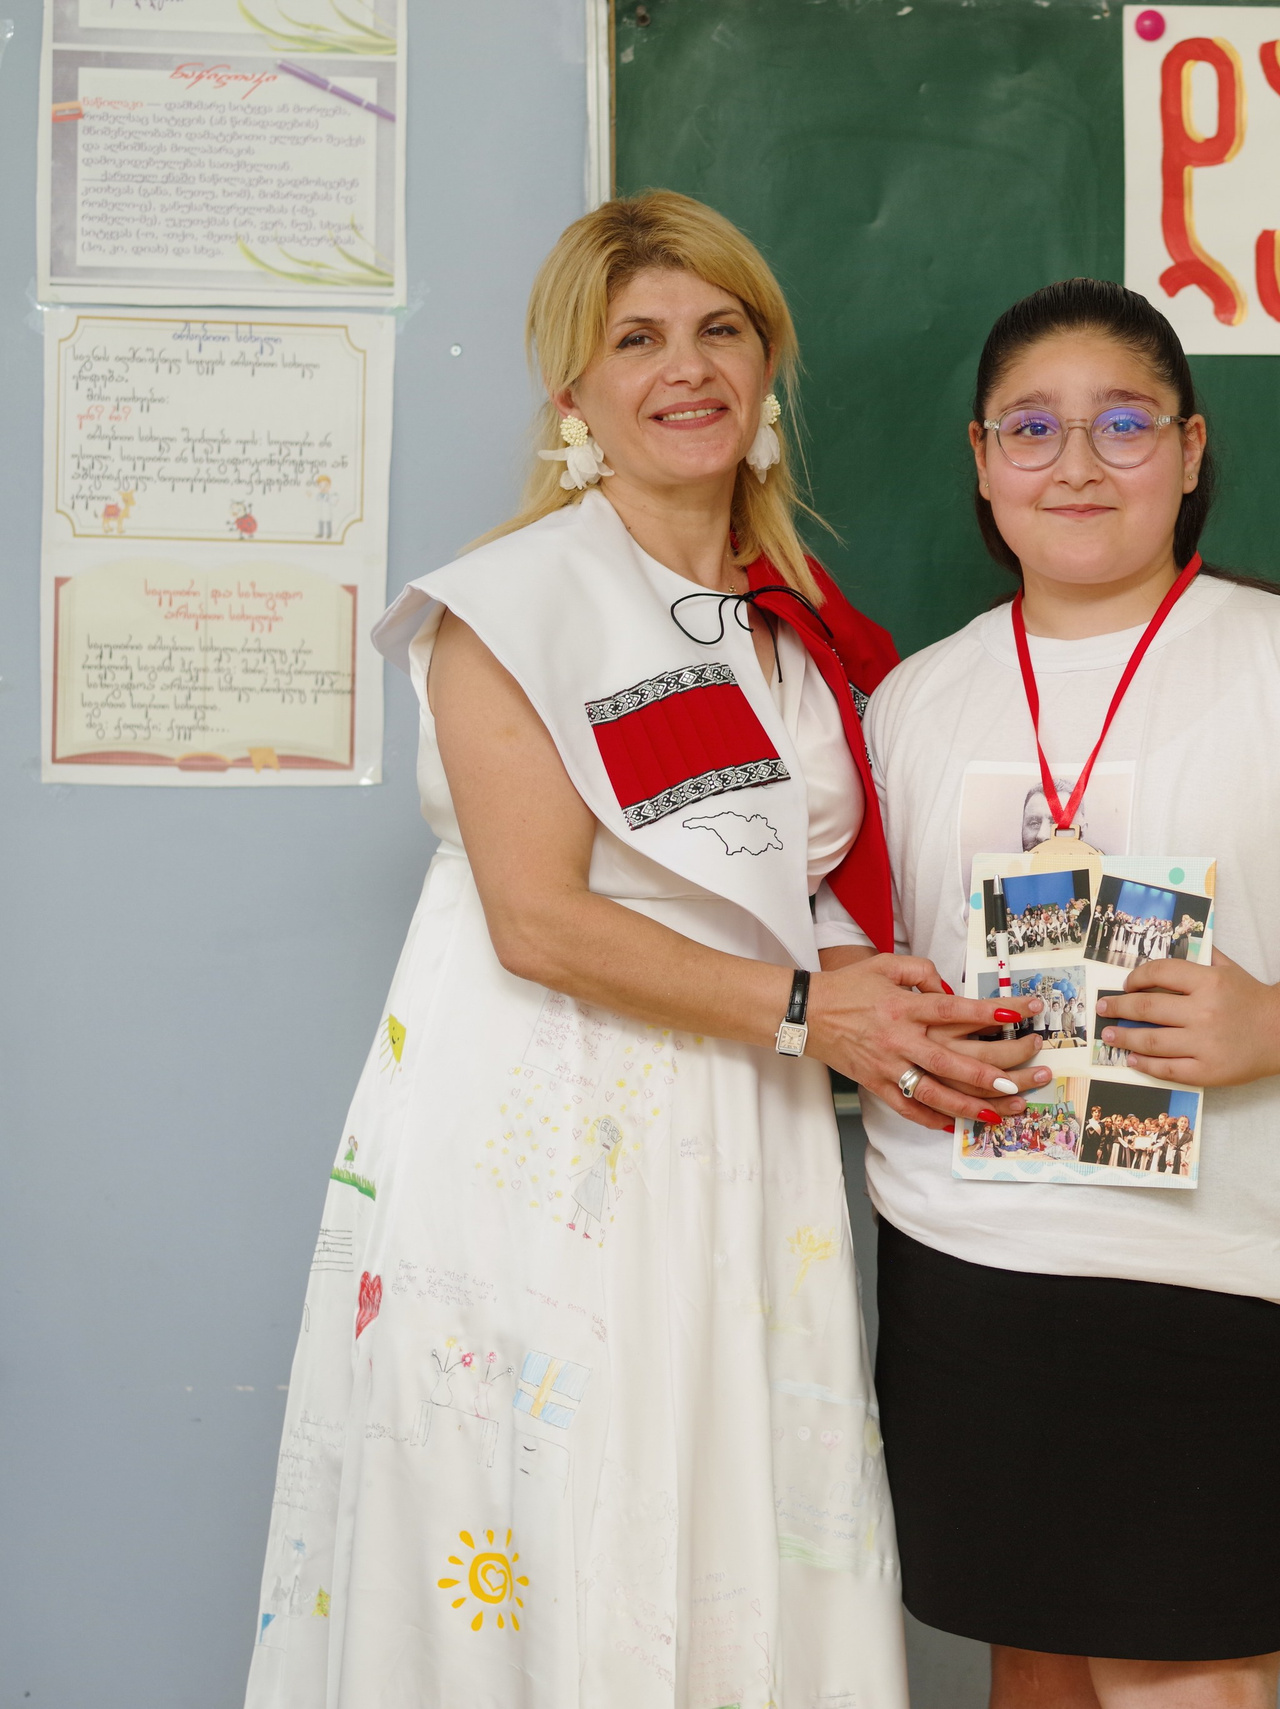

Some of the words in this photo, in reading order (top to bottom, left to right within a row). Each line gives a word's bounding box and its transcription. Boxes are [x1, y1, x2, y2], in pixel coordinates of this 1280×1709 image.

[82, 96, 144, 111] ნაწილაკი
[164, 101, 226, 114] დამხმარე
[228, 102, 273, 115] სიტყვა
[275, 103, 290, 113] ან
[82, 112, 149, 126] რომელსაც
[152, 113, 206, 127] სიტყვის
[209, 115, 227, 127] (ან
[229, 116, 319, 131] წინადადების)
[82, 126, 182, 140] მნიშვნელობაში
[185, 130, 267, 144] დამატებითი
[82, 142, 100, 153] და
[101, 170, 158, 183] ქართულ
[161, 172, 196, 184] ენაში
[199, 173, 274, 187] ნაწილაკები
[81, 185, 134, 197] კითხვას
[81, 227, 133, 241] სიტყვას
[172, 246, 190, 257] და
[210, 588, 233, 605] და
